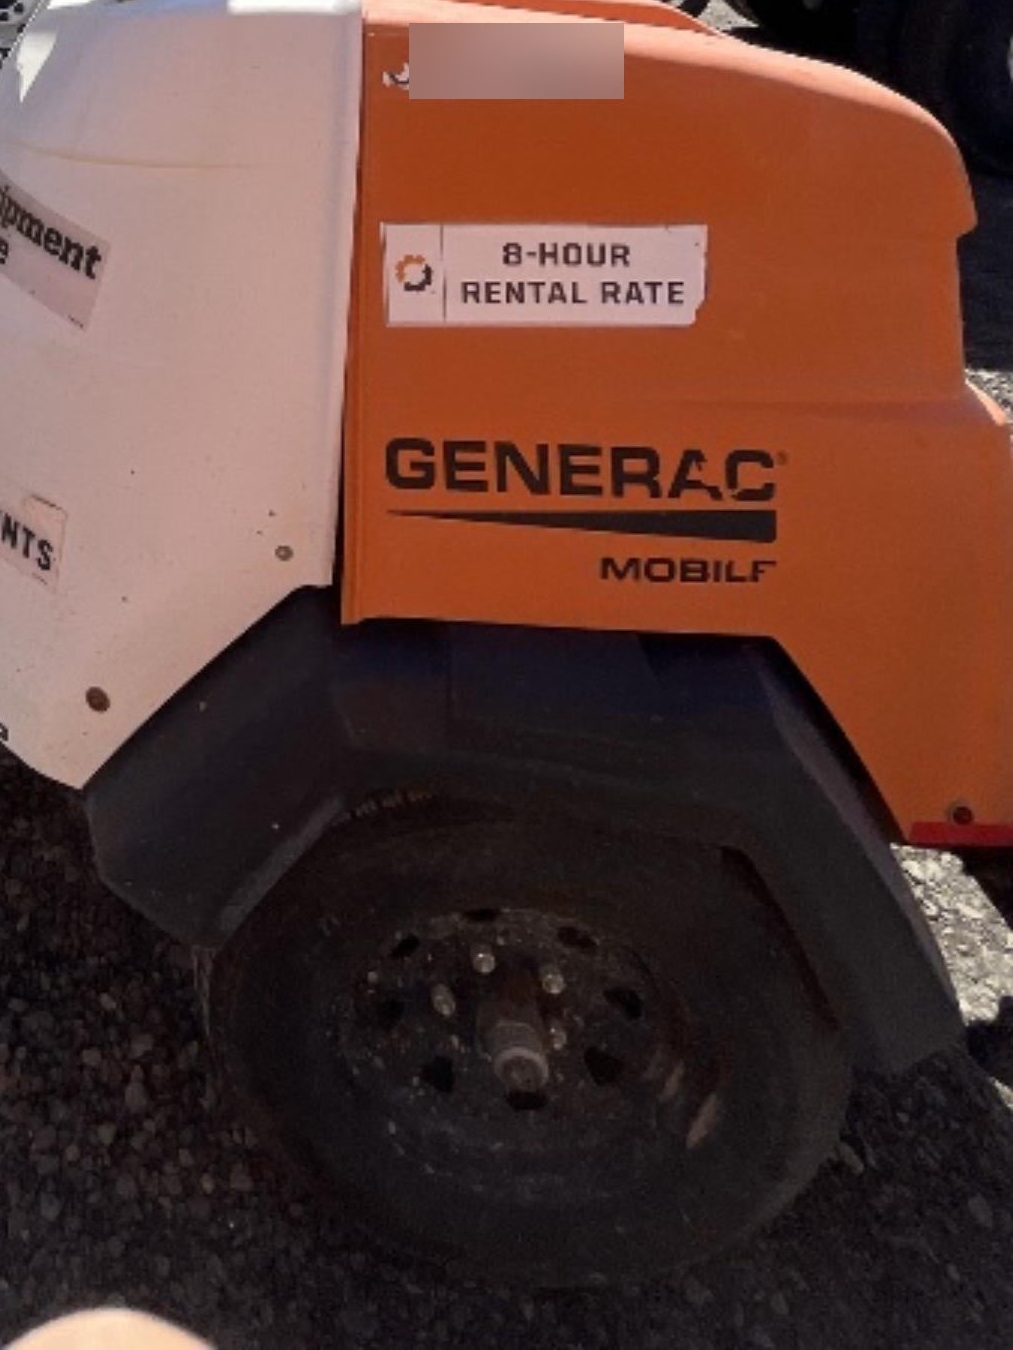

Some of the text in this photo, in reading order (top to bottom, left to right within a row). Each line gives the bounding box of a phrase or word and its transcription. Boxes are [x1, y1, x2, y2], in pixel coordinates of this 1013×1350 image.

[502, 242, 631, 267] 8-HOUR
[461, 281, 685, 304] RENTAL RATE
[385, 437, 778, 502] GENERAC
